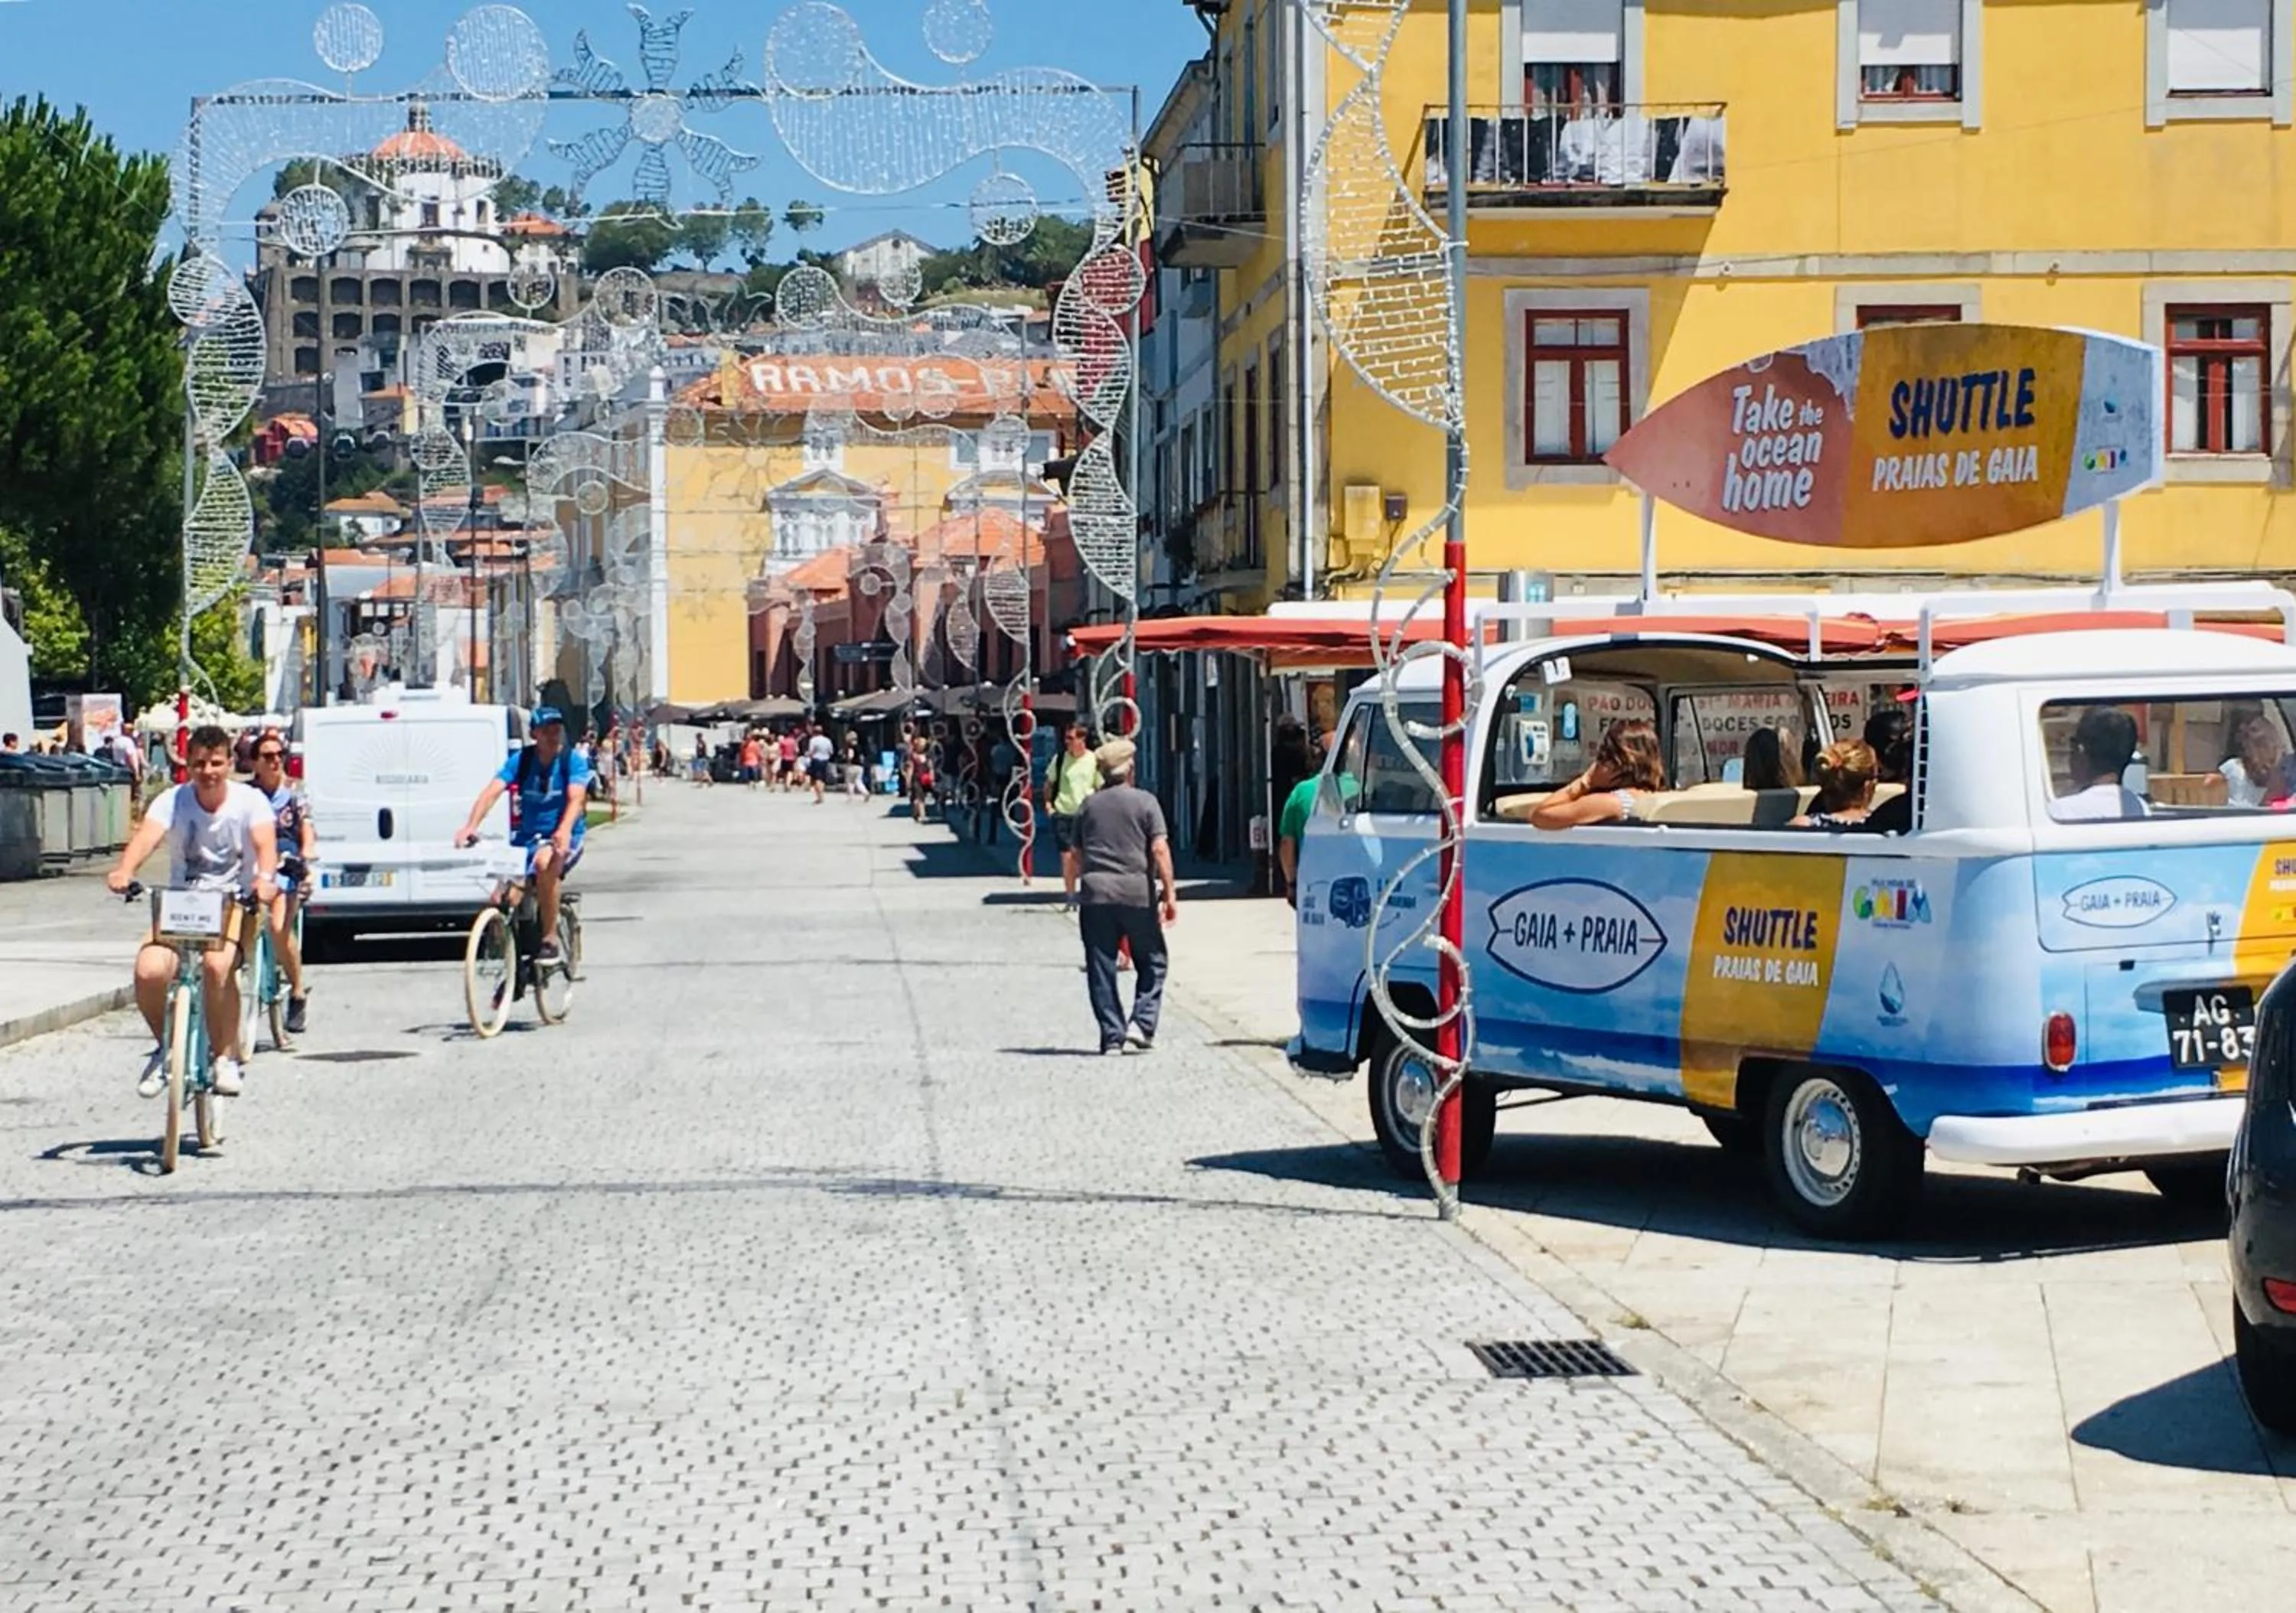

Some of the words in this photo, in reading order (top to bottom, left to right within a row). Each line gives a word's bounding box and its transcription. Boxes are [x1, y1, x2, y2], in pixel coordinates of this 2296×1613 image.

[1732, 383, 1795, 435] Take
[1799, 398, 1824, 426] the
[1889, 367, 2036, 439] SHUTTLE
[1741, 431, 1823, 469] ocean
[1872, 452, 1950, 492] PRAIAS
[1954, 450, 1981, 487] DE
[1987, 445, 2039, 484] GAIA
[1723, 453, 1814, 513] home
[2125, 891, 2160, 908] PRAIA
[1515, 911, 1557, 950] GAIA
[1580, 916, 1637, 956] PRAIA
[1724, 905, 1818, 950] SHUTTLE
[1713, 954, 1761, 982] PRAIAS
[1764, 959, 1782, 982] DE
[1786, 960, 1818, 987] GAIA
[2193, 995, 2231, 1028] AG
[2172, 1025, 2256, 1064] 71-83
